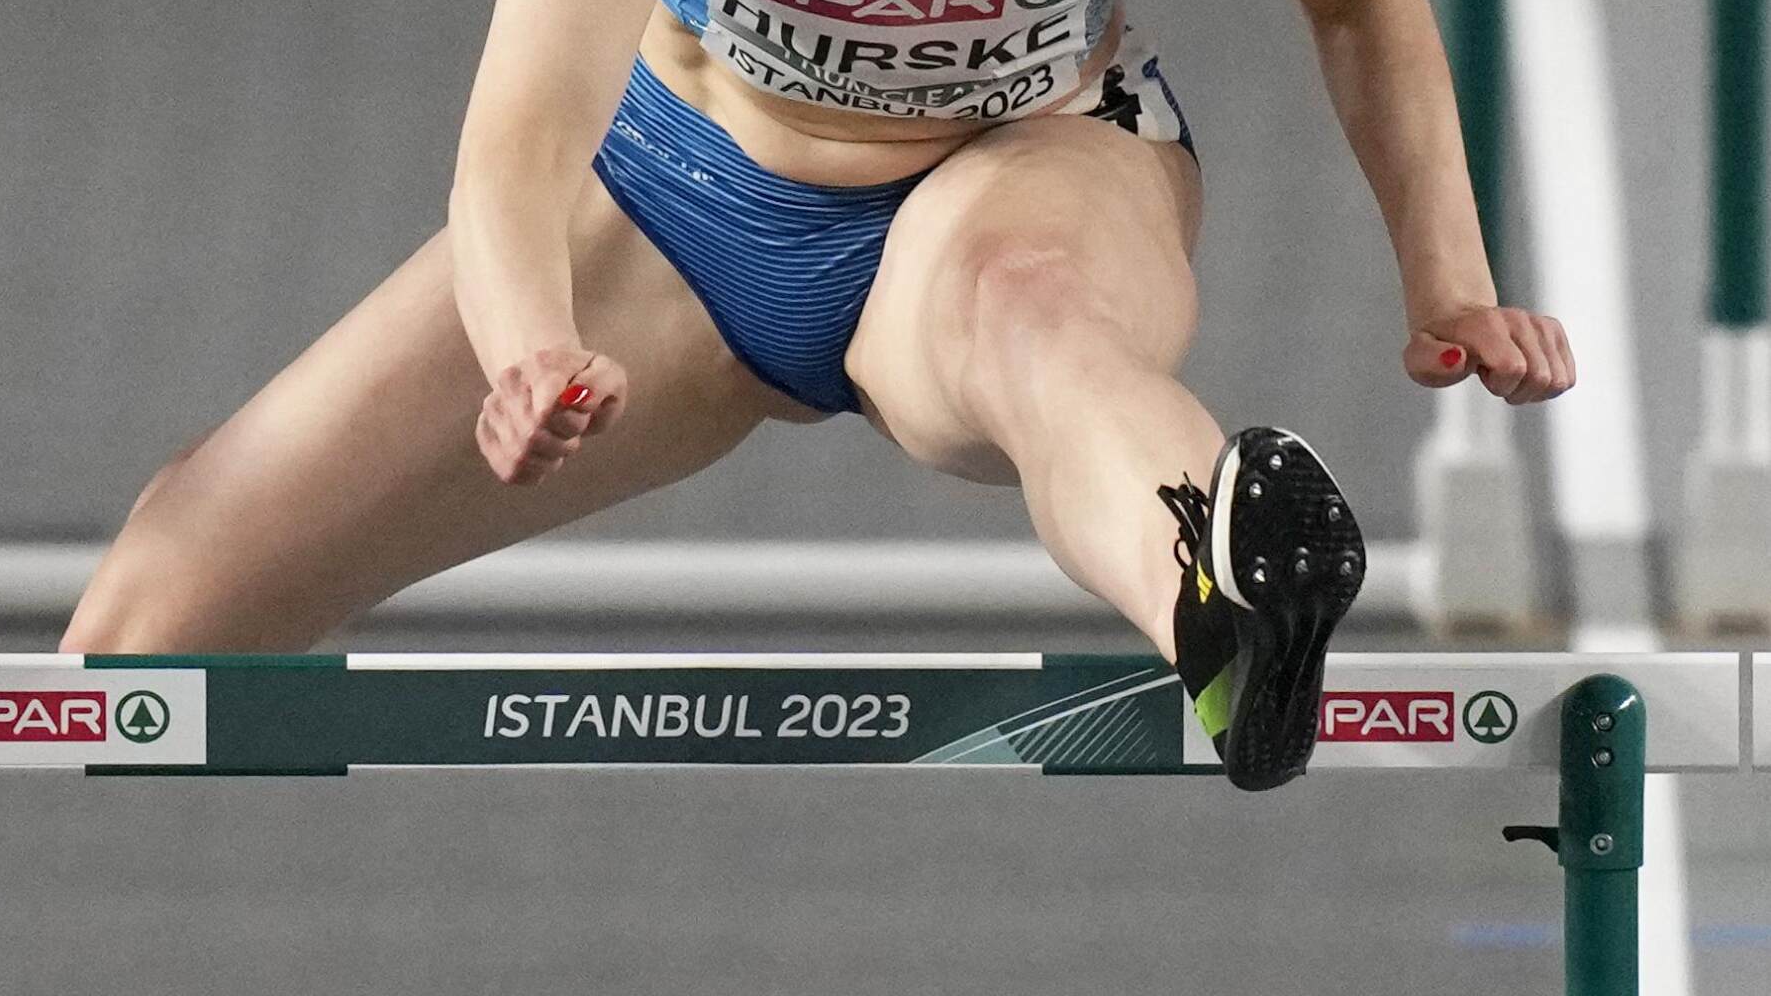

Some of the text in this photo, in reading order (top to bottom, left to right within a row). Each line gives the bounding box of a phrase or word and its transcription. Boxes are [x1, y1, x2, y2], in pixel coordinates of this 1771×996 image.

[881, 84, 982, 106] CLEA
[952, 64, 1054, 121] 2023
[484, 694, 911, 738] ISTANBUL 2023
[1319, 699, 1449, 735] PAR
